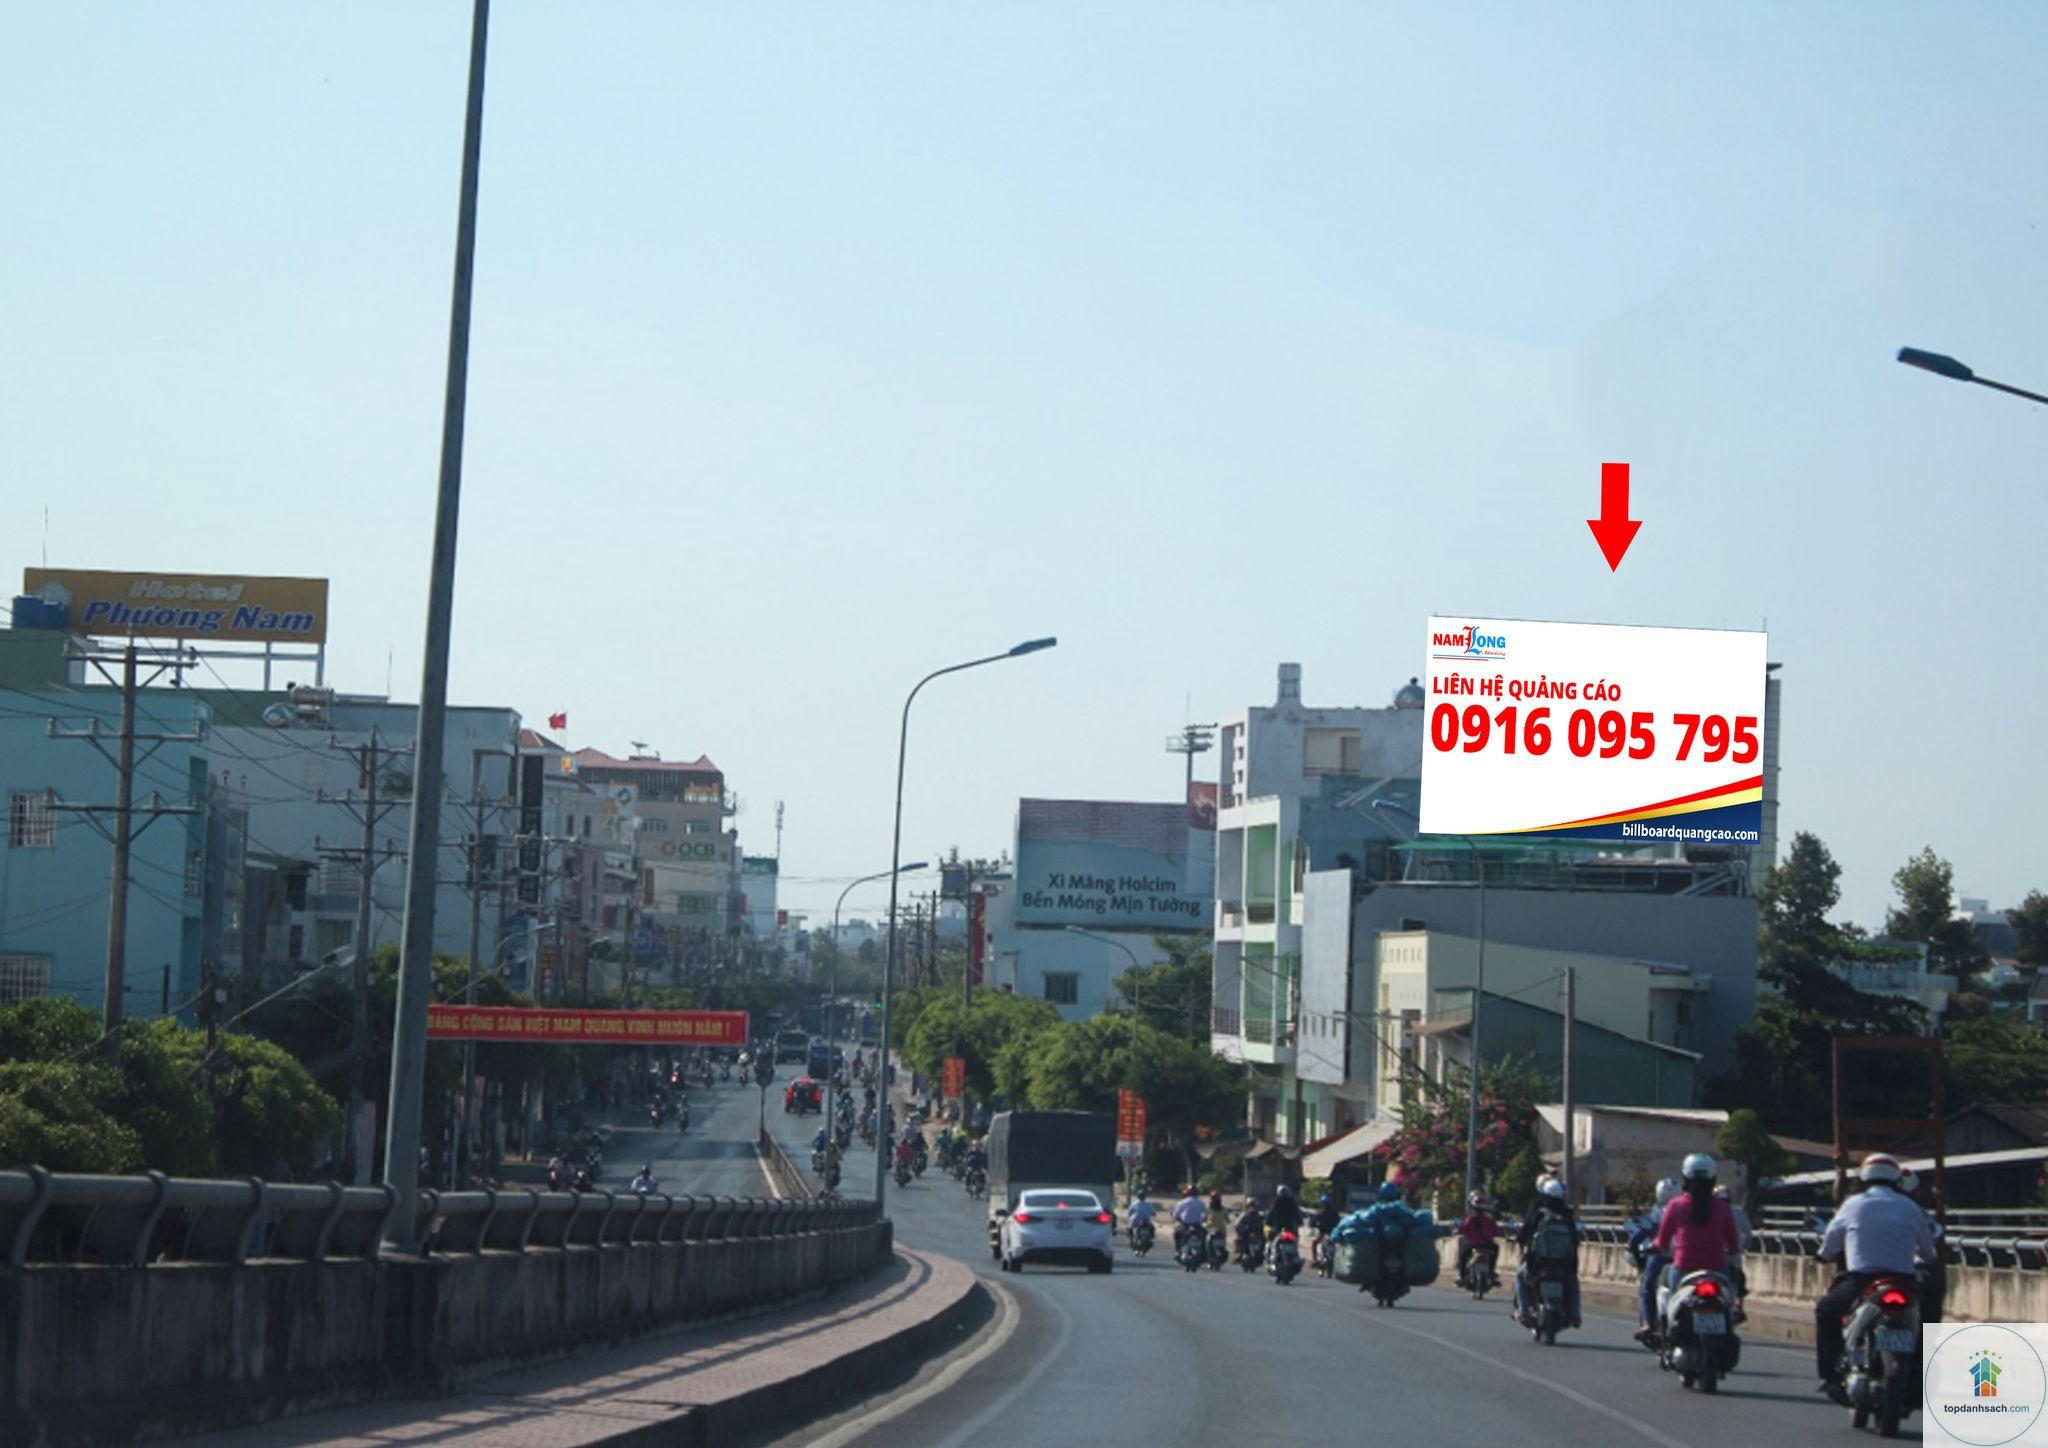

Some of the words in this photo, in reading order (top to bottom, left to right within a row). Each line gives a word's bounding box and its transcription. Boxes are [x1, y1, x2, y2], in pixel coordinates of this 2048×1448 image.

[129, 580, 244, 602] Hotel
[83, 600, 228, 632] Phương
[229, 605, 315, 633] Nam
[1433, 634, 1464, 646] NAM
[1433, 673, 1474, 696] LIÊN
[1480, 674, 1503, 701] HỆ
[1509, 674, 1577, 701] QUẢNG
[1583, 679, 1622, 702] CÁO
[1430, 703, 1552, 756] 0916
[1568, 709, 1656, 760] 095
[1673, 713, 1759, 764] 795
[1622, 823, 1759, 843] billboardquangcao.com
[677, 841, 716, 857] OCB
[1049, 873, 1065, 889] Xi
[1119, 876, 1176, 892] Holcim
[1023, 890, 1053, 908] Bến
[1058, 893, 1106, 913] Móng
[1110, 896, 1143, 914] Mịn
[1149, 896, 1201, 917] Tường
